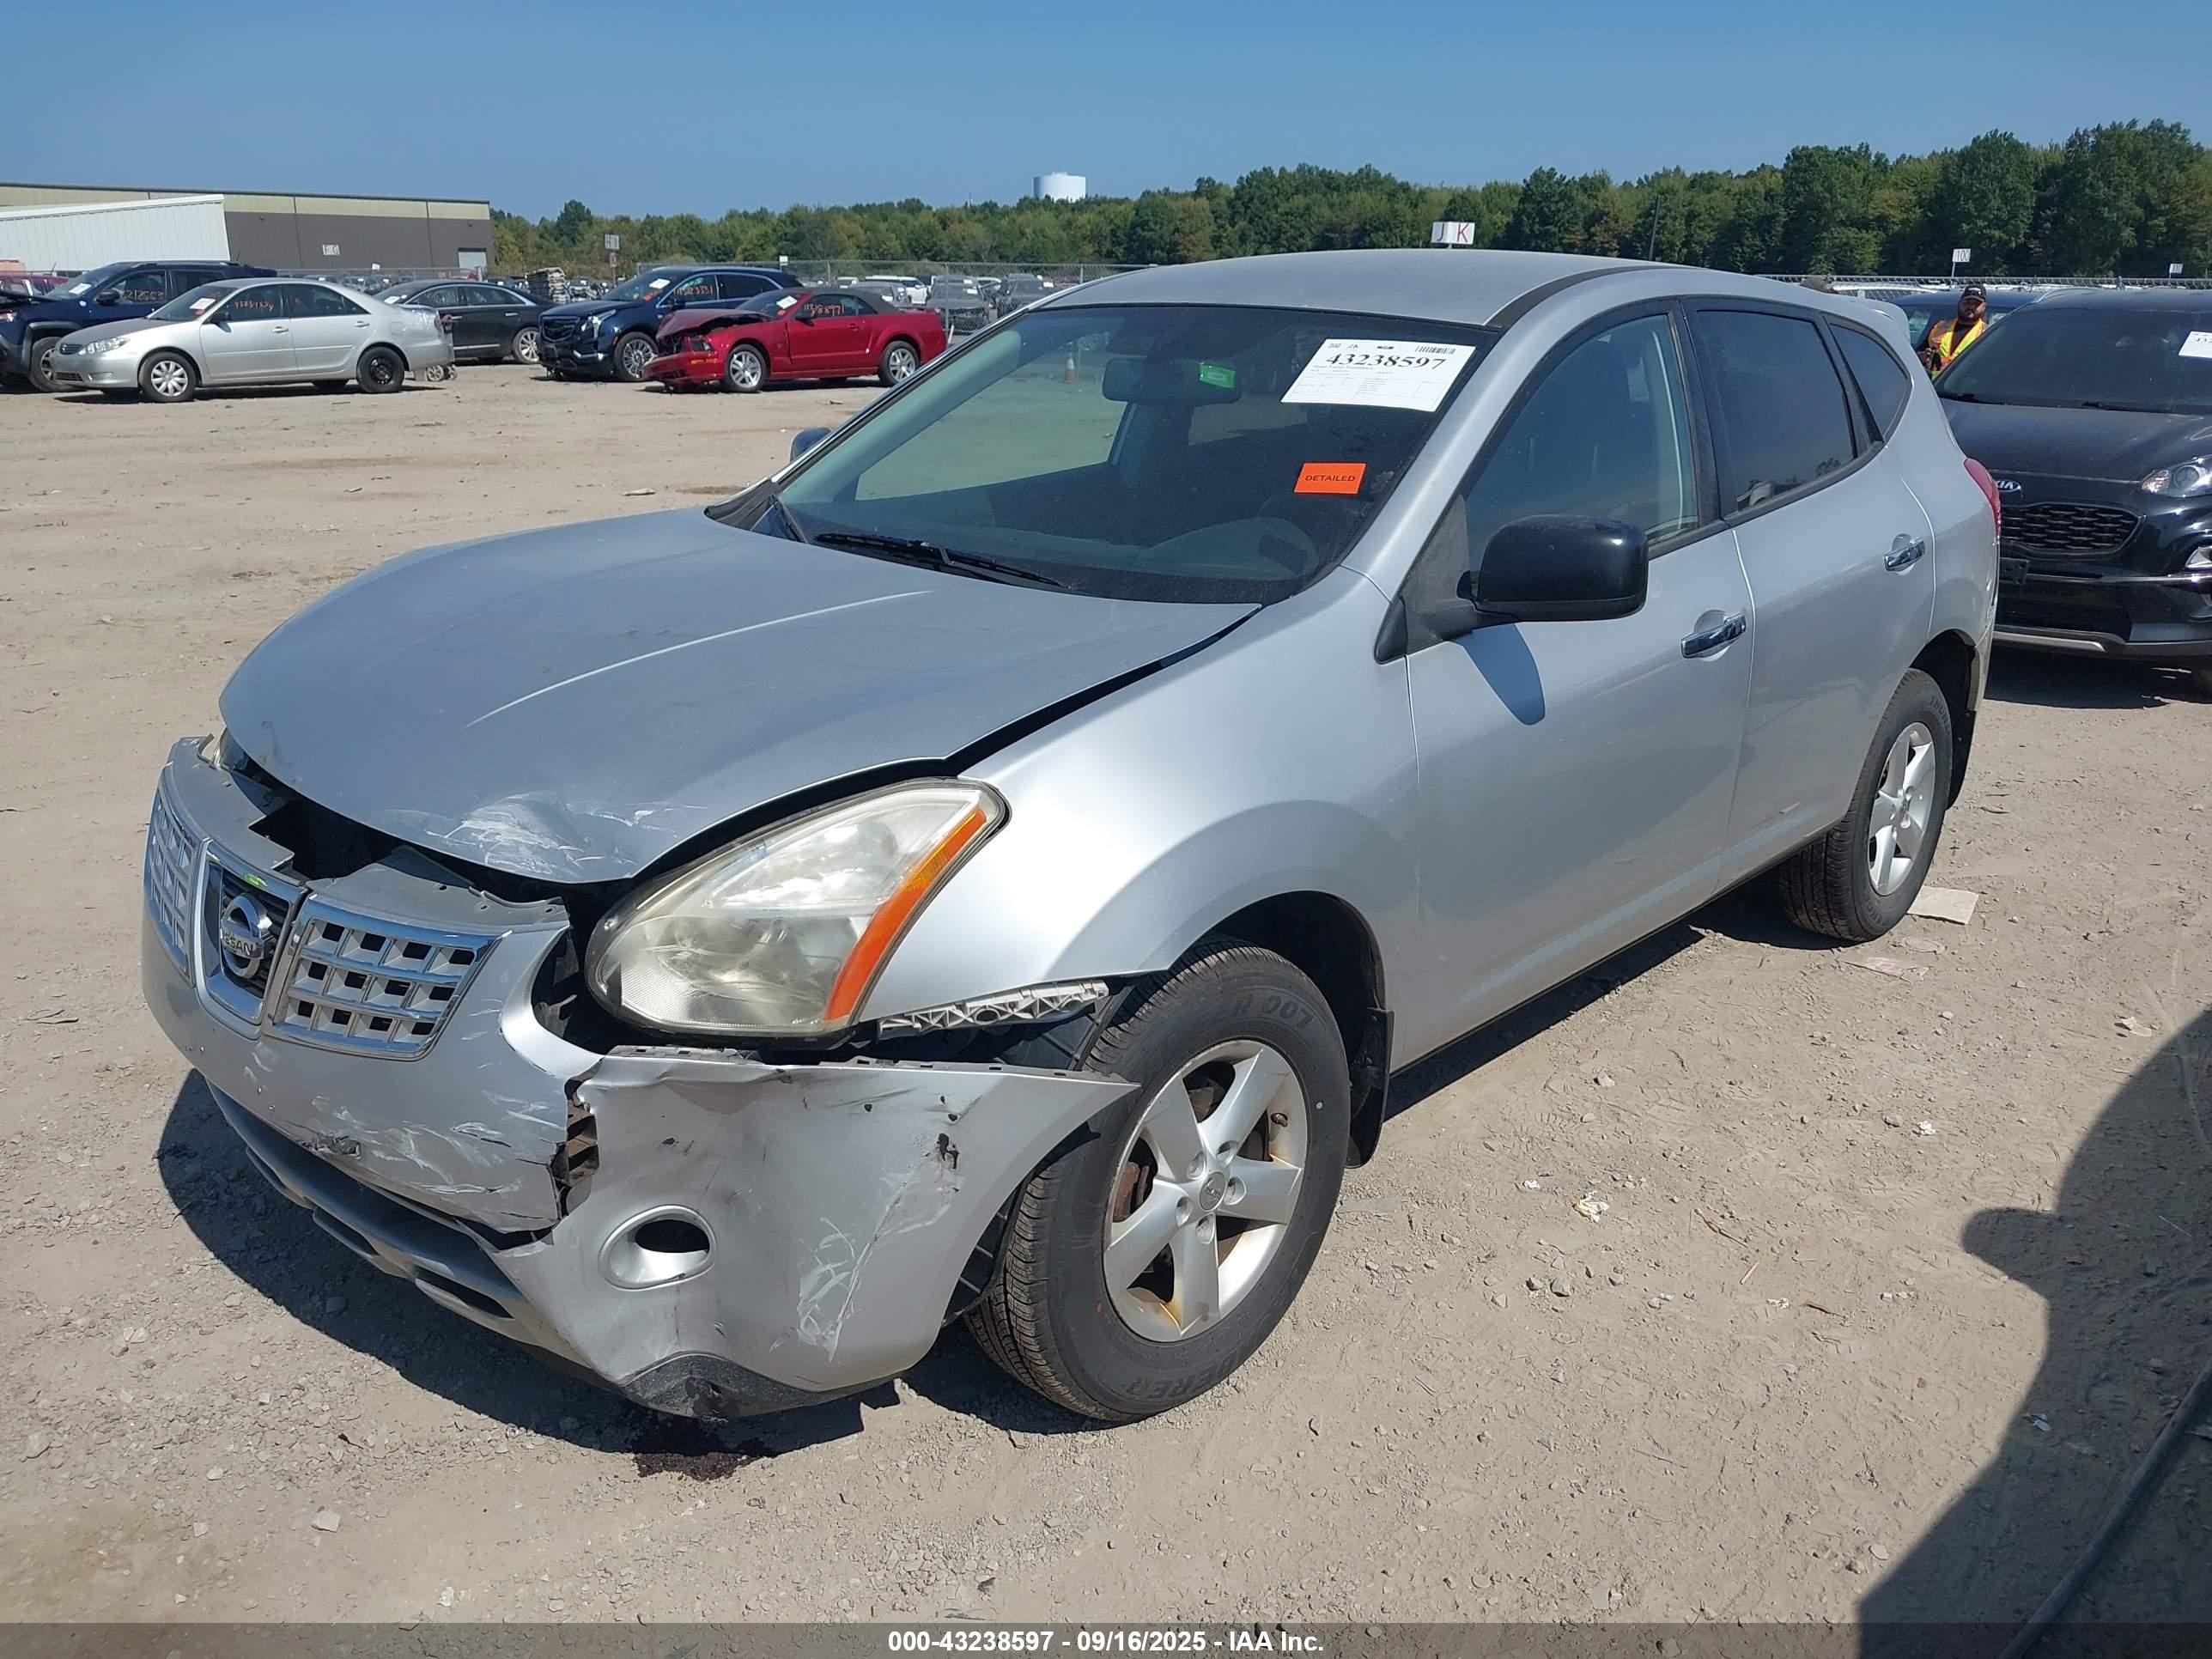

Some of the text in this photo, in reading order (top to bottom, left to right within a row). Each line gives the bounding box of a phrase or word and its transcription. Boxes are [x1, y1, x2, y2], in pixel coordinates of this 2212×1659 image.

[1437, 222, 1469, 243] J K
[1326, 353, 1447, 370] 43238597
